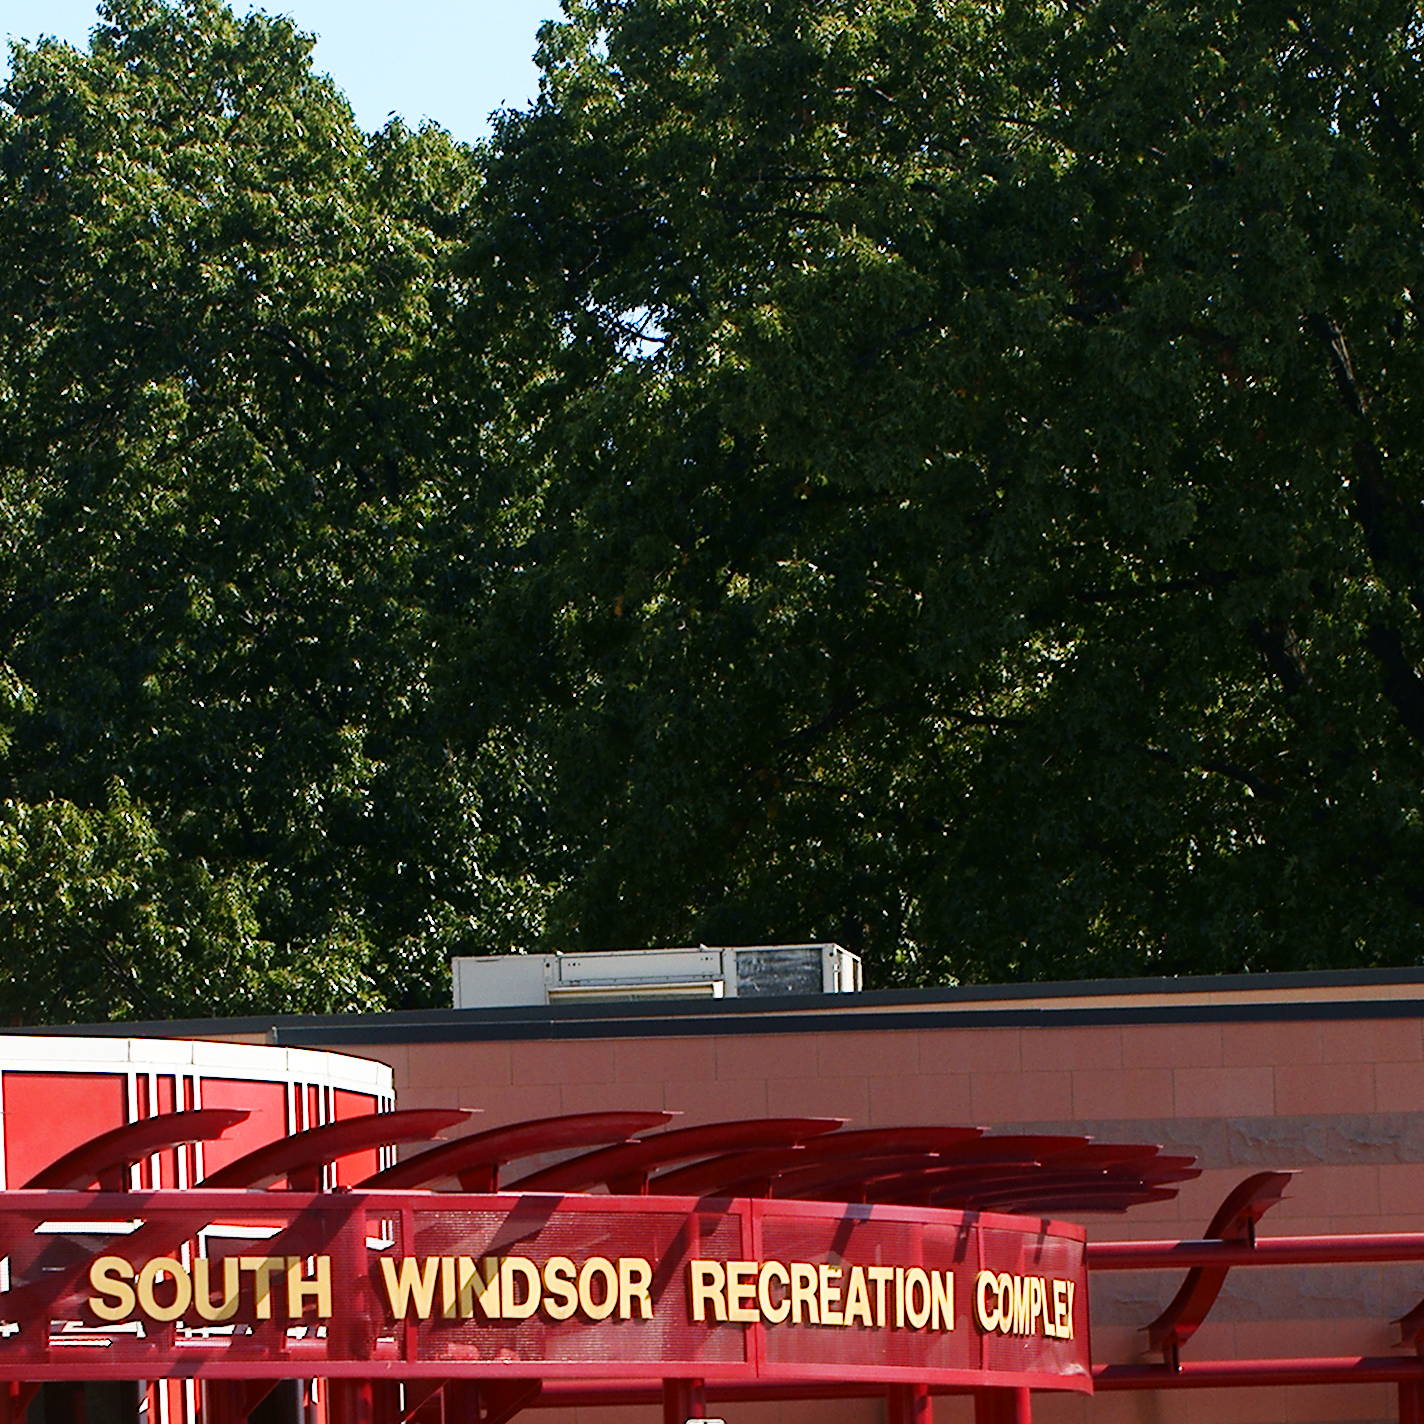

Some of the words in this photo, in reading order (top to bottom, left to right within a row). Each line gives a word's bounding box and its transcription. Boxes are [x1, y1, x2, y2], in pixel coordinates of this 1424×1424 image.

[88, 1255, 333, 1322] SOUTH
[379, 1255, 654, 1321] WINDSOR
[690, 1259, 955, 1332] RECREATION
